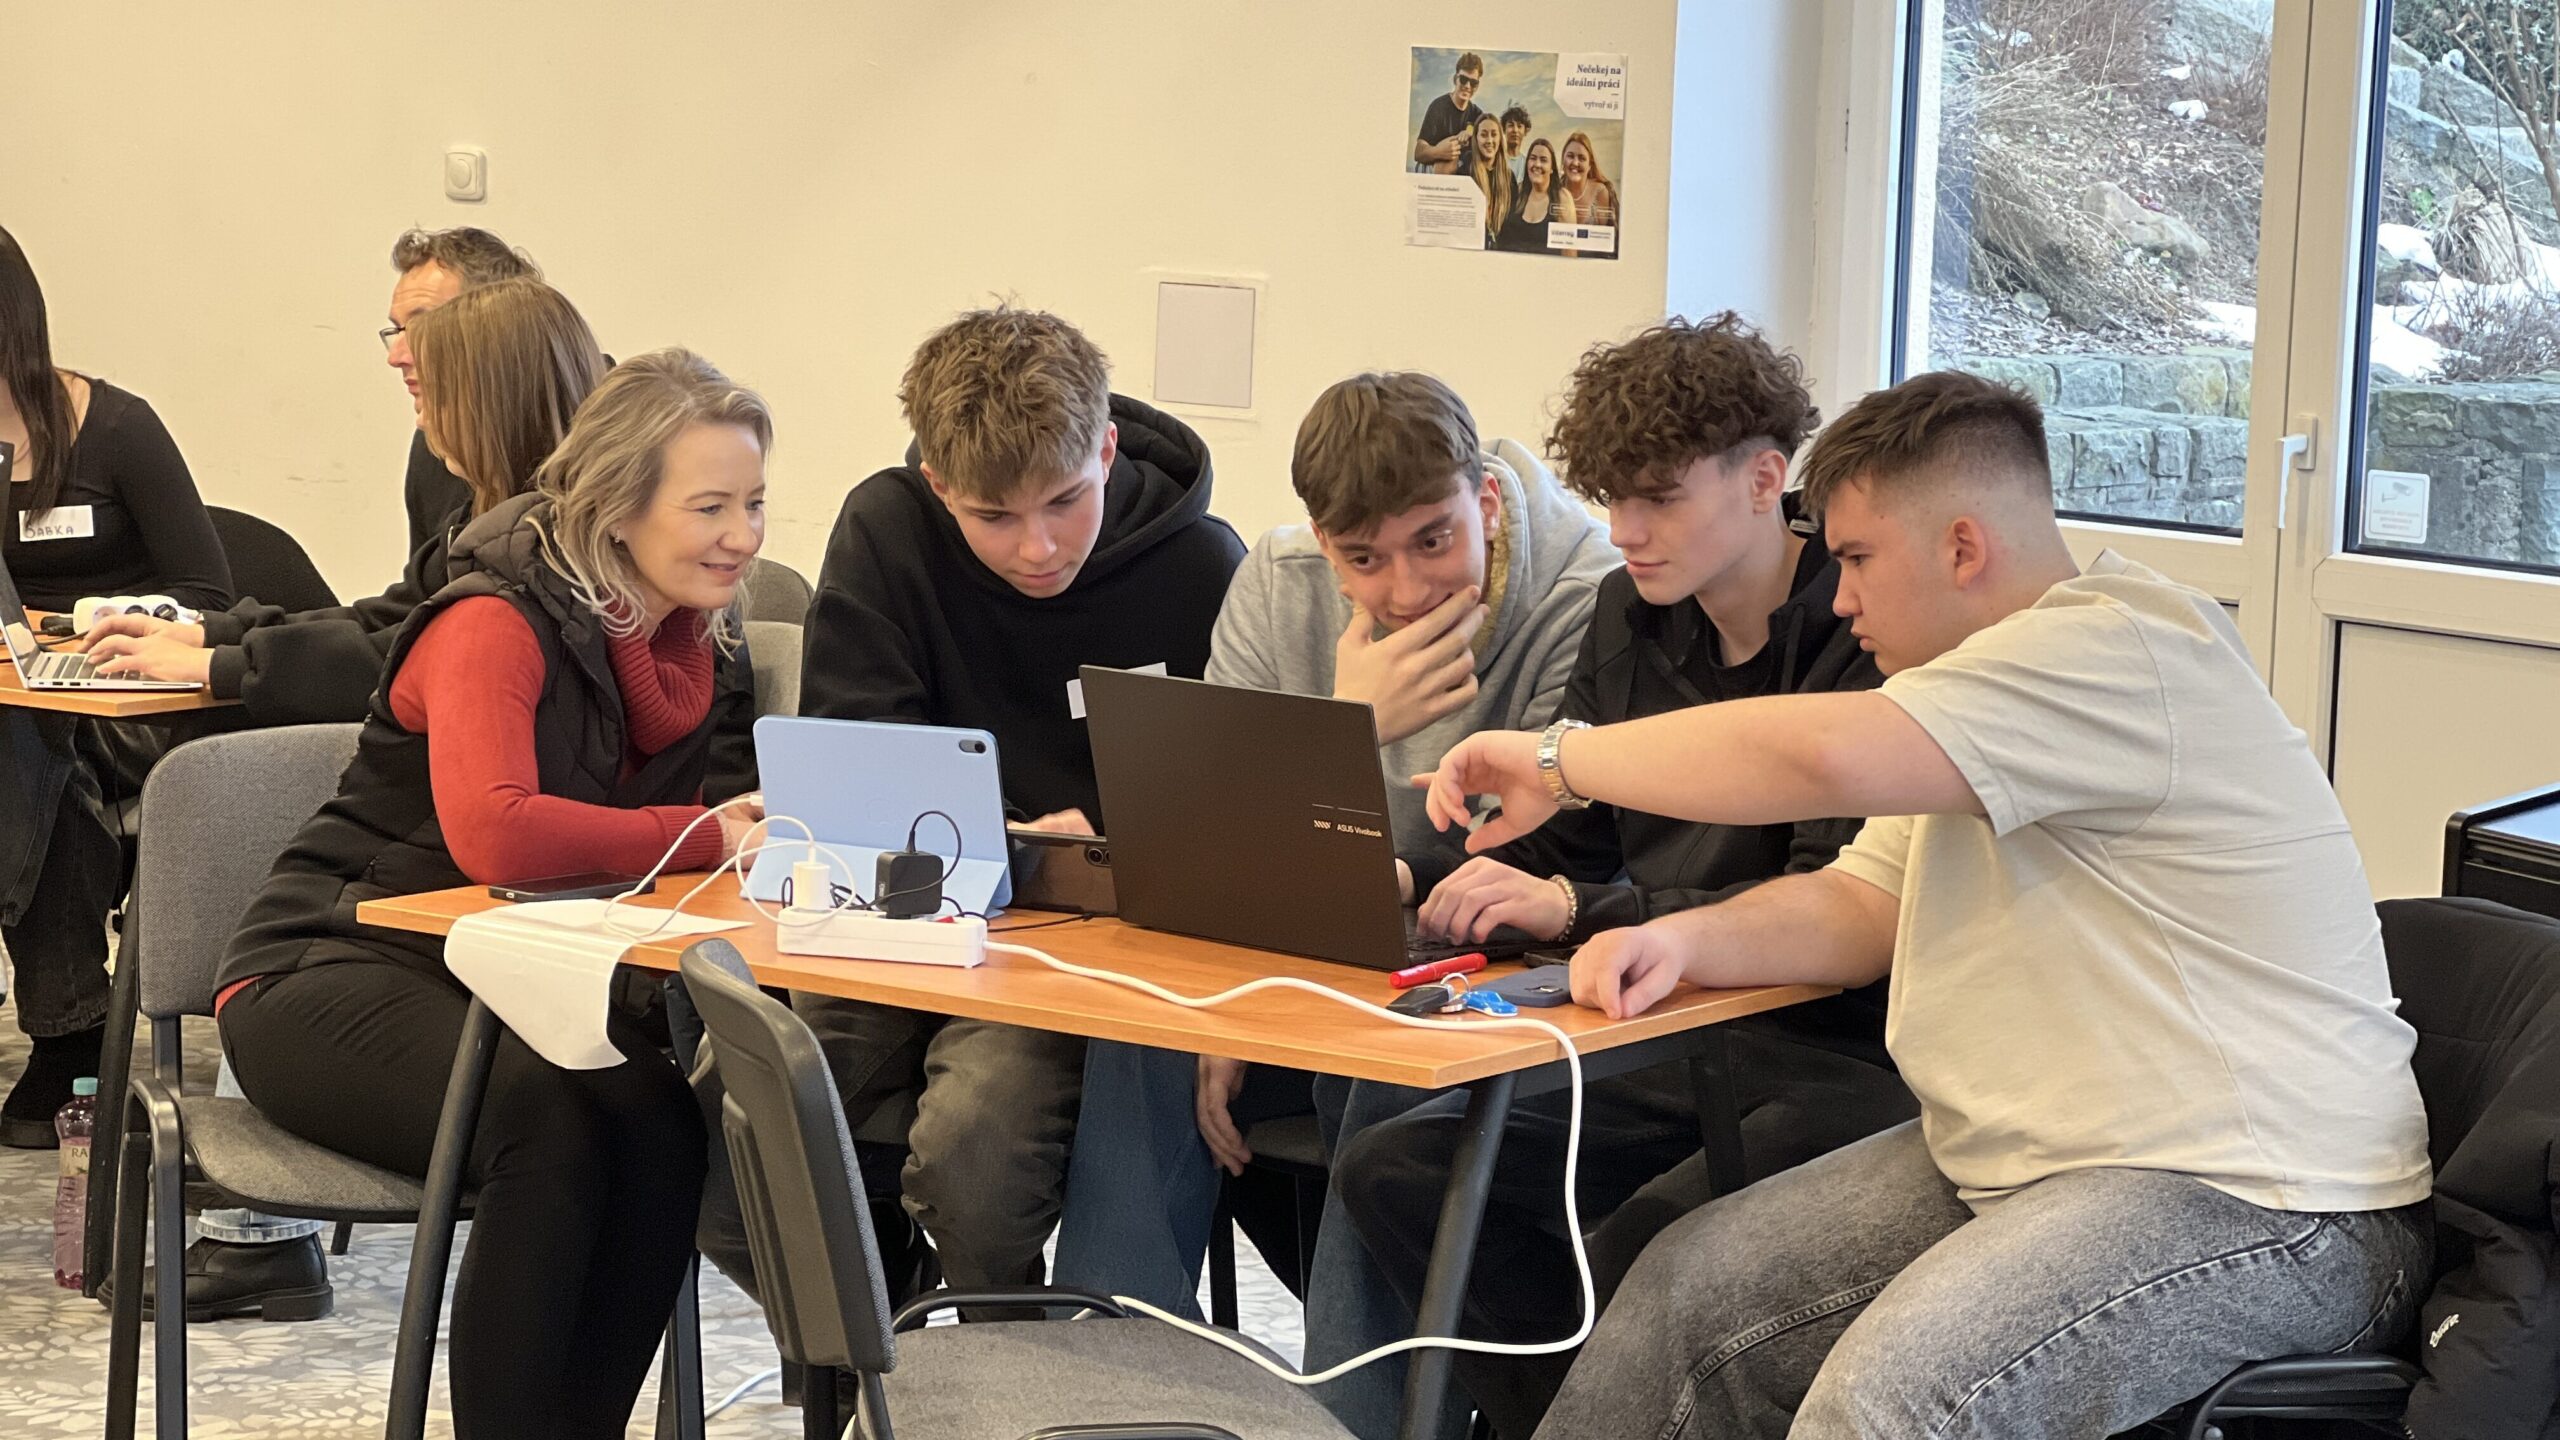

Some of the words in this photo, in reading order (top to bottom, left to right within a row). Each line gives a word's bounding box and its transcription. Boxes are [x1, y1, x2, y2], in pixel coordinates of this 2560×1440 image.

[1577, 64, 1609, 77] Nečekej
[1610, 67, 1622, 75] na
[1566, 77, 1596, 87] ideální
[1597, 79, 1621, 90] práci
[1337, 823, 1354, 834] ASUS
